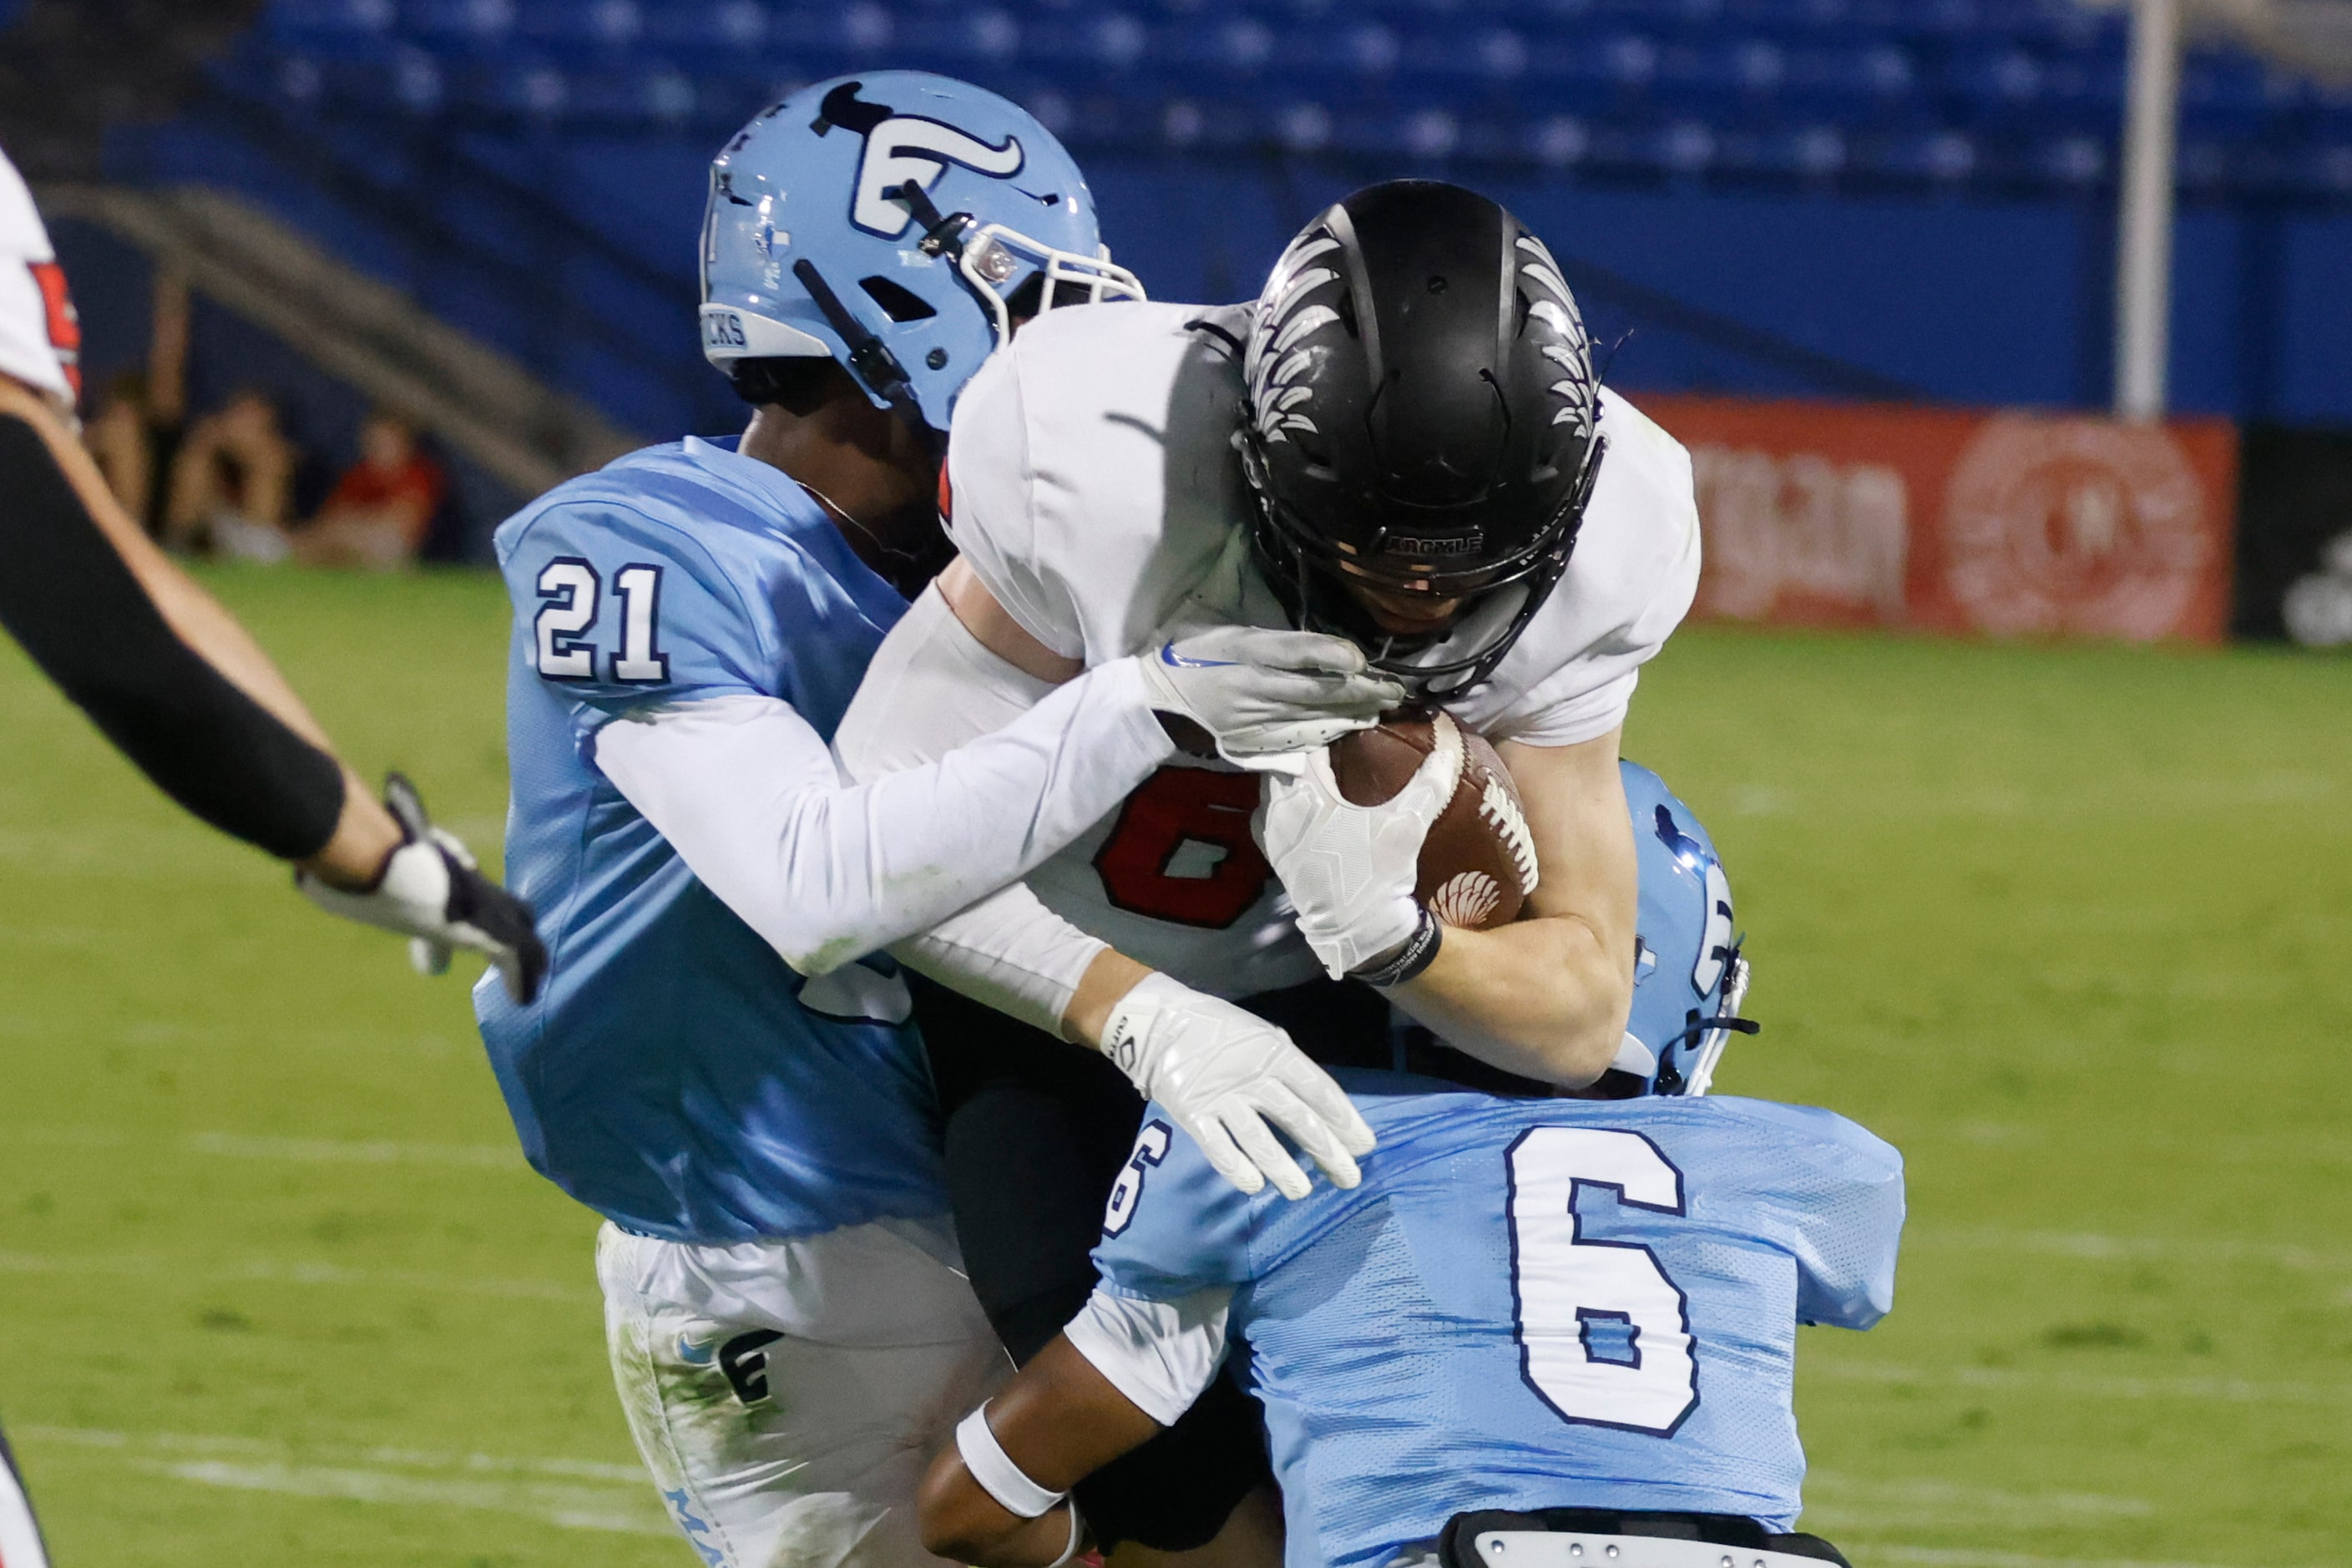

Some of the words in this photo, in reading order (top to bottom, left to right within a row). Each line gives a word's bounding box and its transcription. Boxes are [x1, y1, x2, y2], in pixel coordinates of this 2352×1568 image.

[534, 556, 670, 683] 21
[1102, 1119, 1172, 1240] 6
[1503, 1125, 1701, 1438] 6
